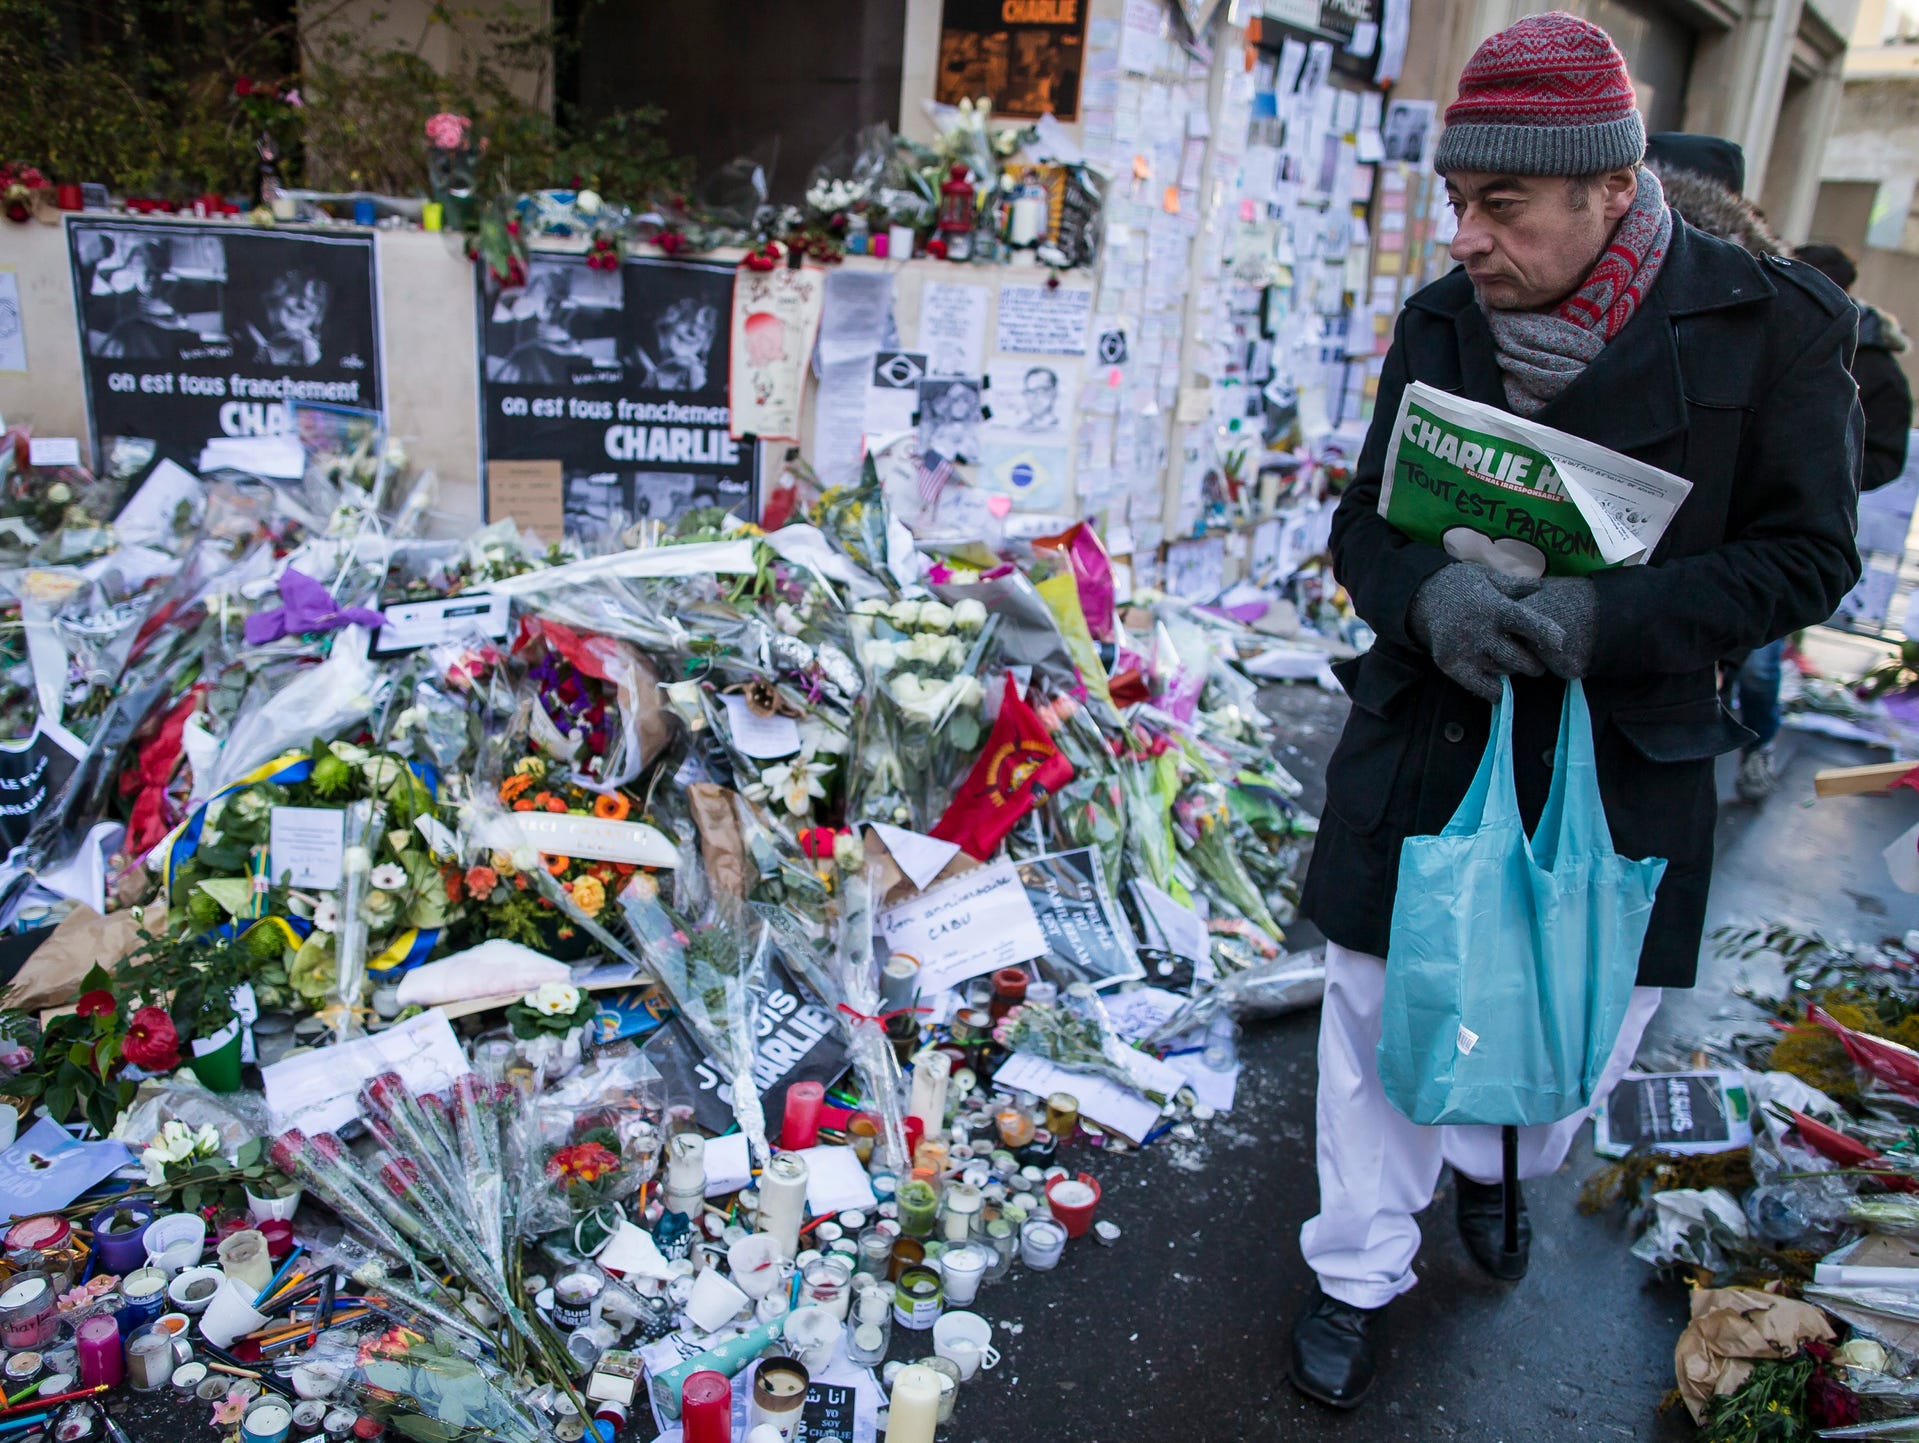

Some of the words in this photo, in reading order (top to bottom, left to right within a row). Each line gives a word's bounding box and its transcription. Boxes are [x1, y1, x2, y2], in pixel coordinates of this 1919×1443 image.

[108, 373, 135, 392] on
[140, 373, 174, 394] est
[178, 373, 225, 396] tous
[229, 373, 360, 401] franchement
[501, 397, 528, 416] on
[531, 398, 564, 418] est
[569, 397, 613, 420] tous
[617, 398, 730, 425] franchemen
[604, 425, 740, 465] CHARLIE
[1403, 414, 1533, 487] CHARLIE
[1398, 459, 1458, 501] TOUT
[1455, 488, 1506, 522] EST
[1466, 469, 1501, 487] JOURNAL
[1500, 481, 1562, 502] IRRESPONSABLE
[518, 819, 557, 833] ERCI
[928, 912, 972, 941] CABU
[821, 1419, 841, 1429] SOY
[825, 1408, 839, 1418] YO
